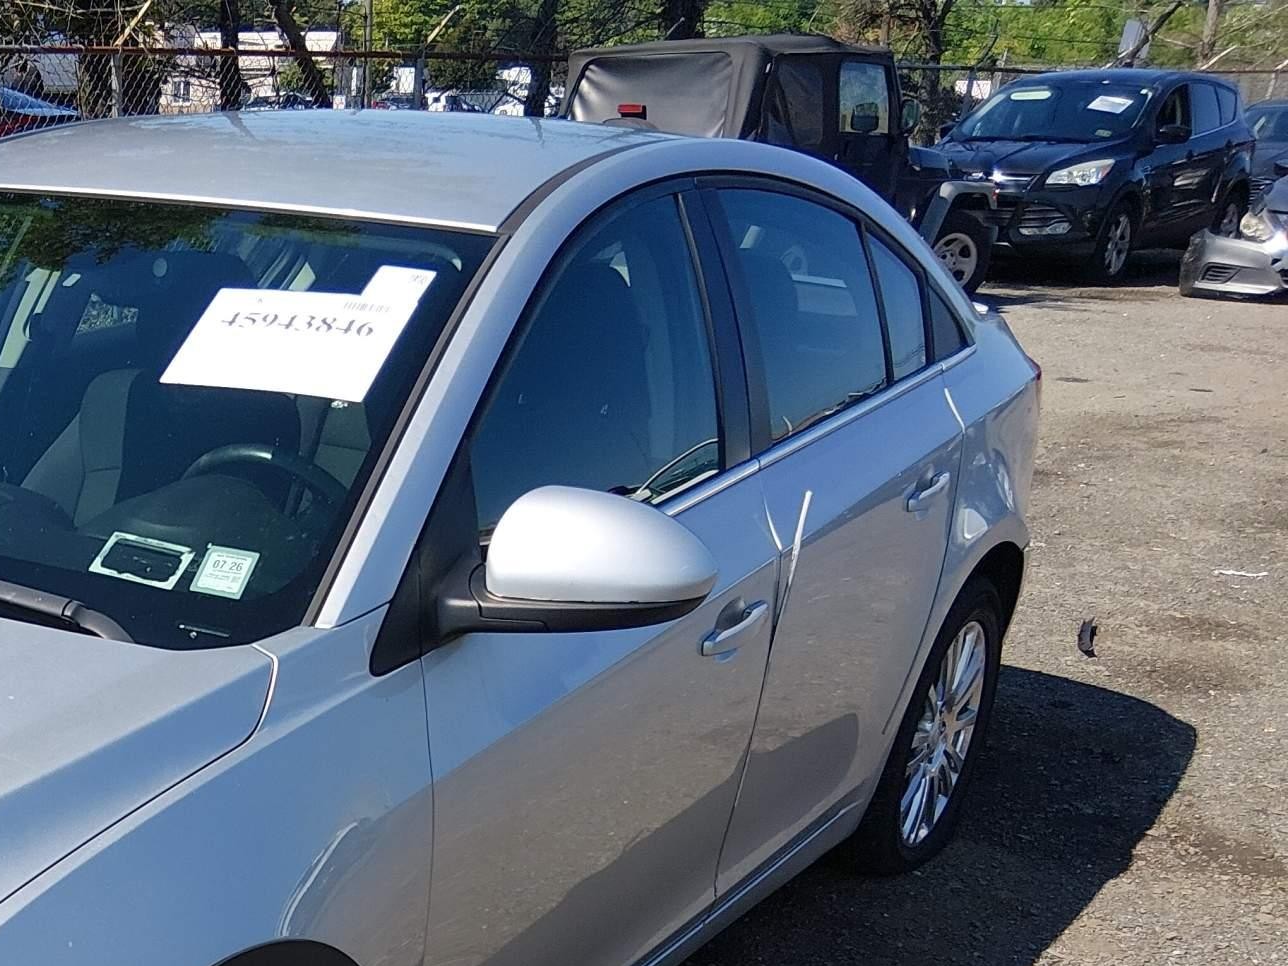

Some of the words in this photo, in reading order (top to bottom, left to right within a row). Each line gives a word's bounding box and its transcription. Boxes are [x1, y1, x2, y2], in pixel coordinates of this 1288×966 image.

[220, 312, 374, 336] 45943846
[212, 560, 227, 569] 07
[229, 561, 244, 571] 26
